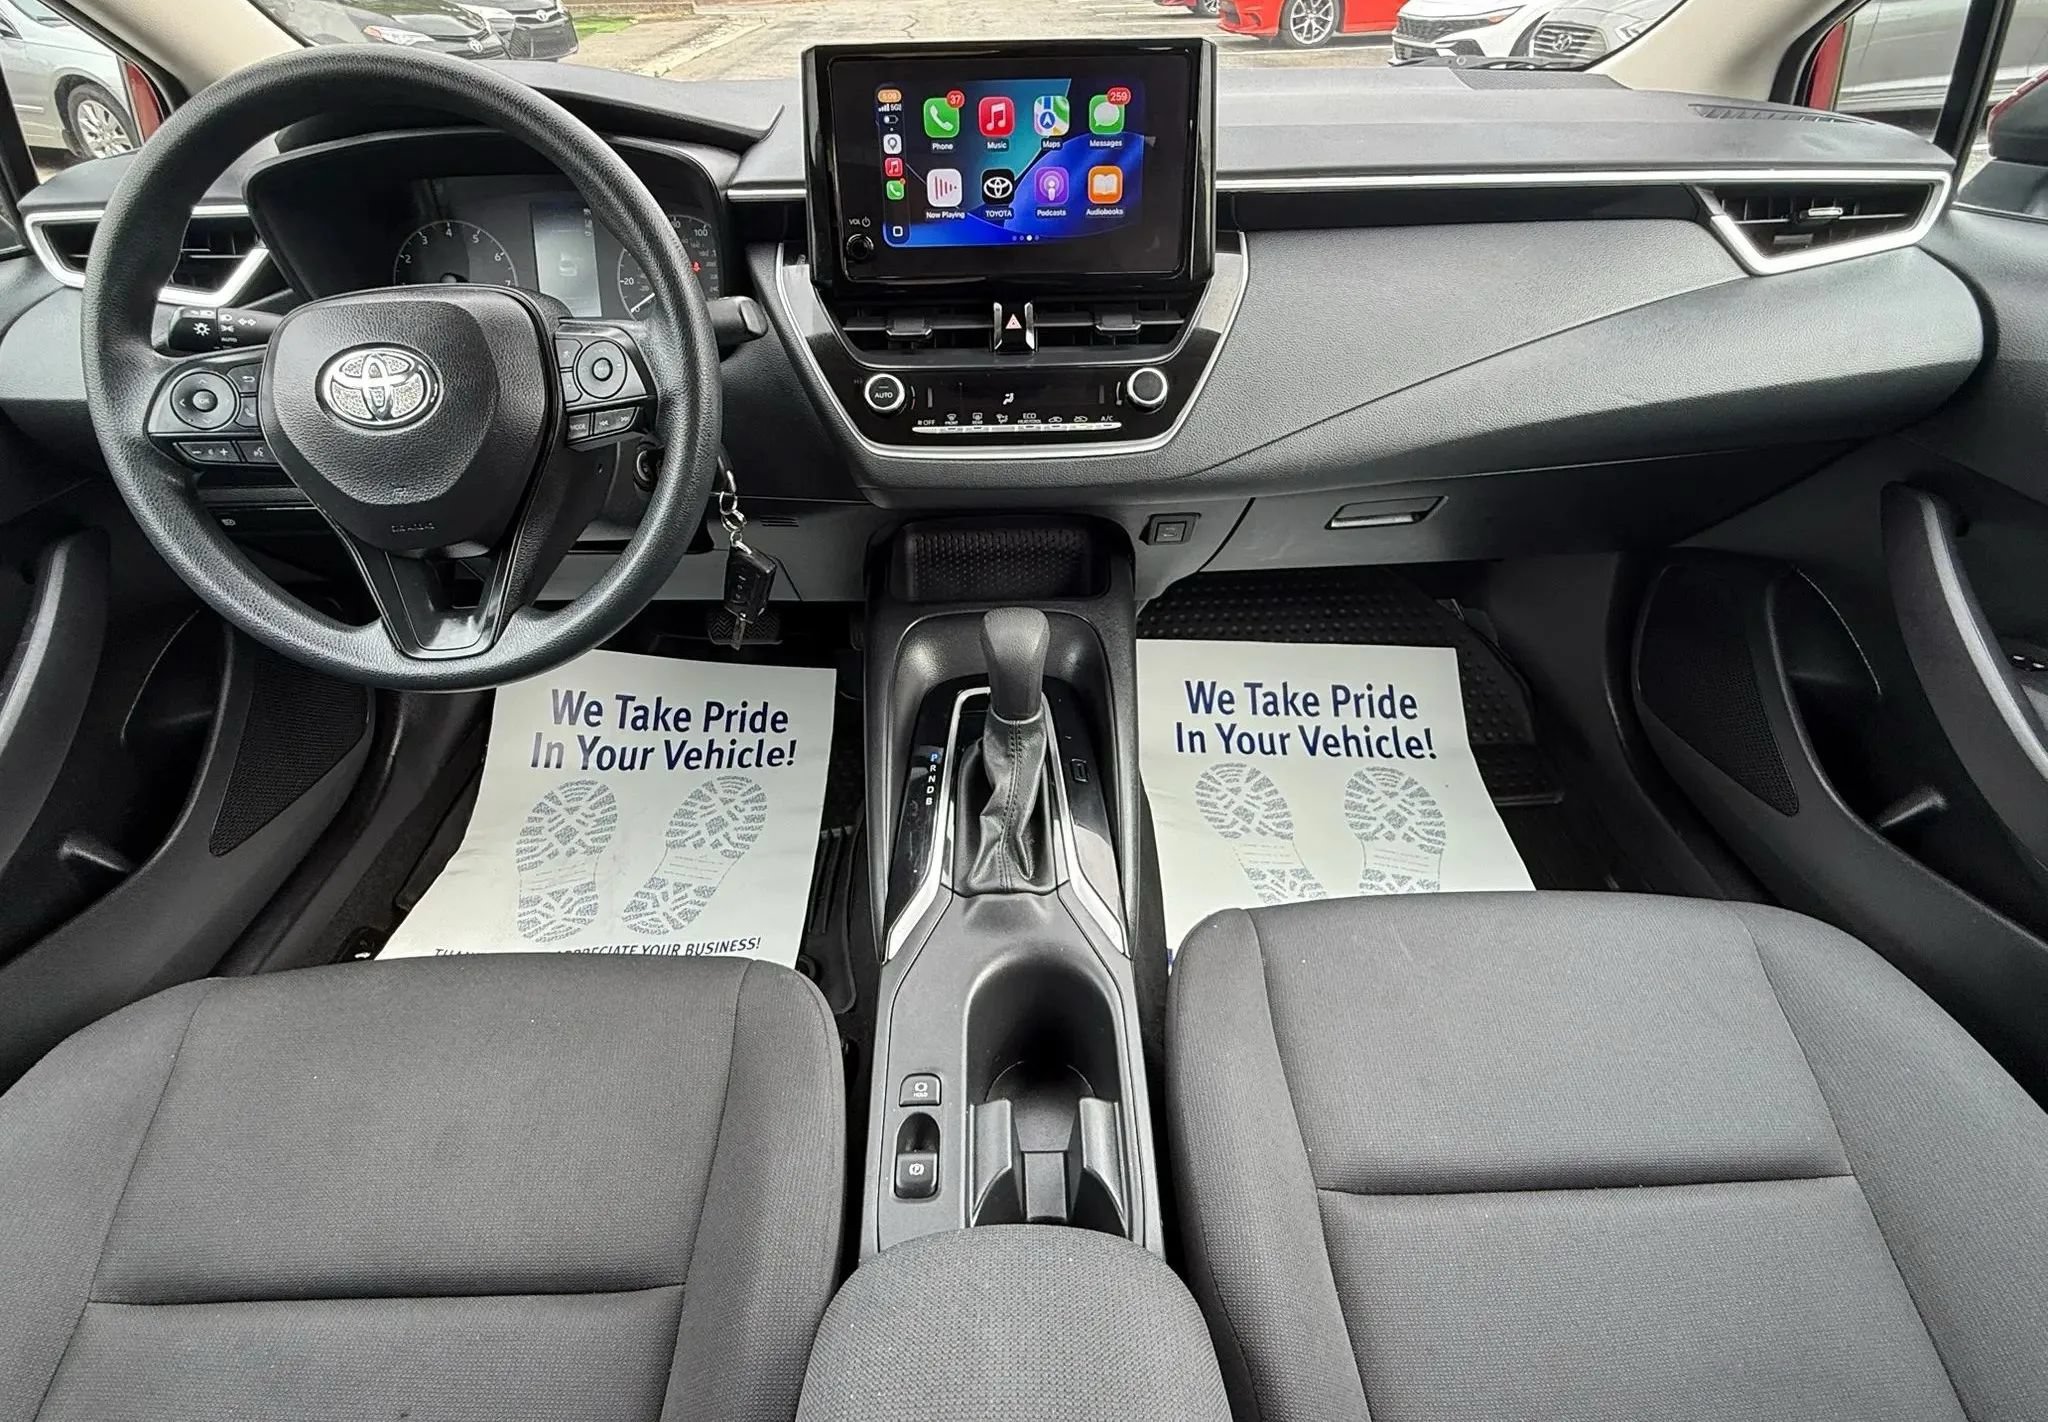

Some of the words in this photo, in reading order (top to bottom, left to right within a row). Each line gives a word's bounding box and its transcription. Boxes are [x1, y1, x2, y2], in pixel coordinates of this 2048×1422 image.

[950, 94, 961, 105] 37
[1110, 92, 1128, 101] 259
[932, 142, 953, 150] Phone
[1042, 141, 1060, 150] Maps
[1090, 140, 1122, 149] Messages
[926, 211, 941, 219] Now
[942, 210, 965, 220] Playing
[985, 210, 1012, 218] TOYOTA
[1037, 209, 1066, 217] Podcasts
[1086, 208, 1124, 216] Audiobooks
[445, 228, 453, 237] 4
[694, 228, 708, 237] 100
[421, 235, 428, 245] 3
[473, 234, 480, 243] 5
[404, 254, 411, 264] 2
[494, 252, 502, 262] 6
[623, 277, 634, 286] 20
[874, 391, 893, 399] AUTO
[1185, 680, 1235, 715] We
[1244, 682, 1320, 718] Take
[1331, 683, 1418, 720] Pride
[551, 689, 603, 727] We
[615, 694, 692, 732] Take
[703, 701, 789, 734] Pride
[1176, 722, 1207, 753] In
[1215, 723, 1291, 756] Your
[1298, 725, 1437, 760] Vehicle!
[531, 732, 564, 769] In
[577, 735, 655, 771] Your
[664, 739, 797, 770] Vehicle!
[930, 753, 938, 762] P
[930, 764, 936, 772] R
[928, 775, 936, 783] N
[926, 785, 935, 794] D
[925, 797, 933, 806] B
[685, 937, 761, 956] BUSINESS!
